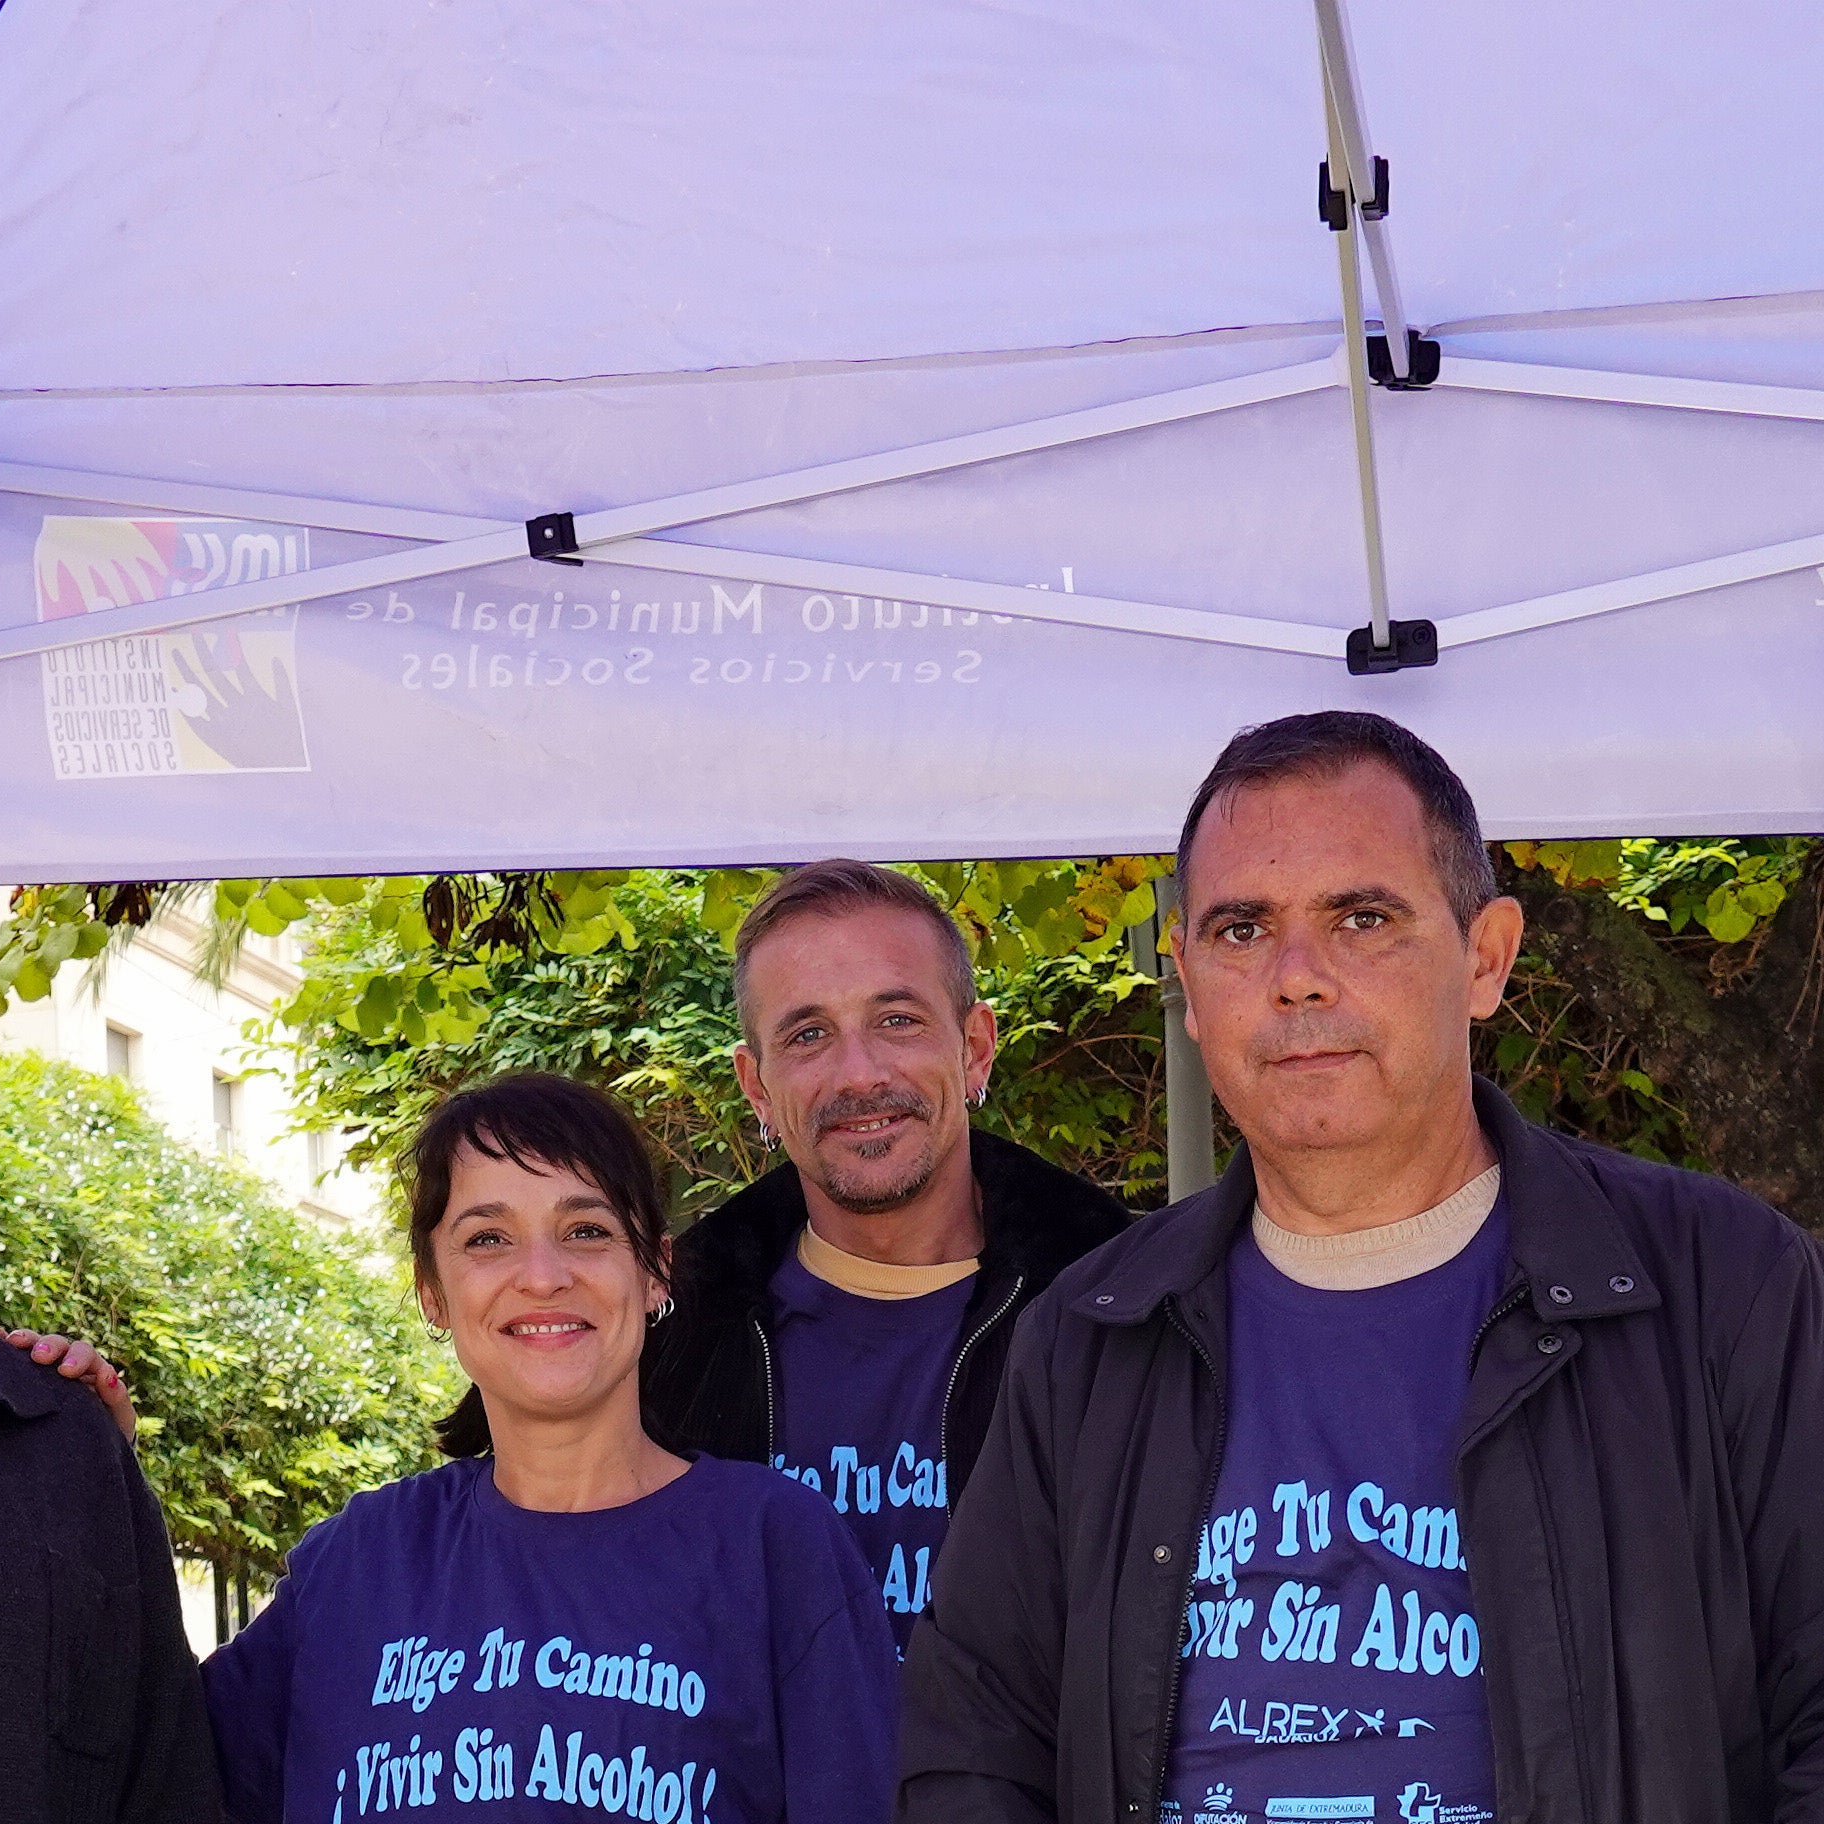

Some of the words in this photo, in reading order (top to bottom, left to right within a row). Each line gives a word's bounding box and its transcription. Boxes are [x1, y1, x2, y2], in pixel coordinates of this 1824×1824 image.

[831, 1445, 880, 1514] Tu
[1273, 1480, 1330, 1556] Tu
[1347, 1481, 1467, 1572] Cam
[1260, 1581, 1340, 1663] Sin
[1351, 1583, 1483, 1677] Alco
[371, 1636, 466, 1713] Elige
[473, 1626, 526, 1693] Tu
[534, 1635, 707, 1718] Camino
[1209, 1697, 1349, 1739] ALREX
[453, 1727, 515, 1804] Sin
[1271, 1805, 1293, 1815] JUNTA
[1296, 1804, 1306, 1814] DE
[1308, 1802, 1369, 1814] EXTREMADURA
[1439, 1804, 1478, 1815] Servicio
[1439, 1811, 1493, 1824] Extremeño
